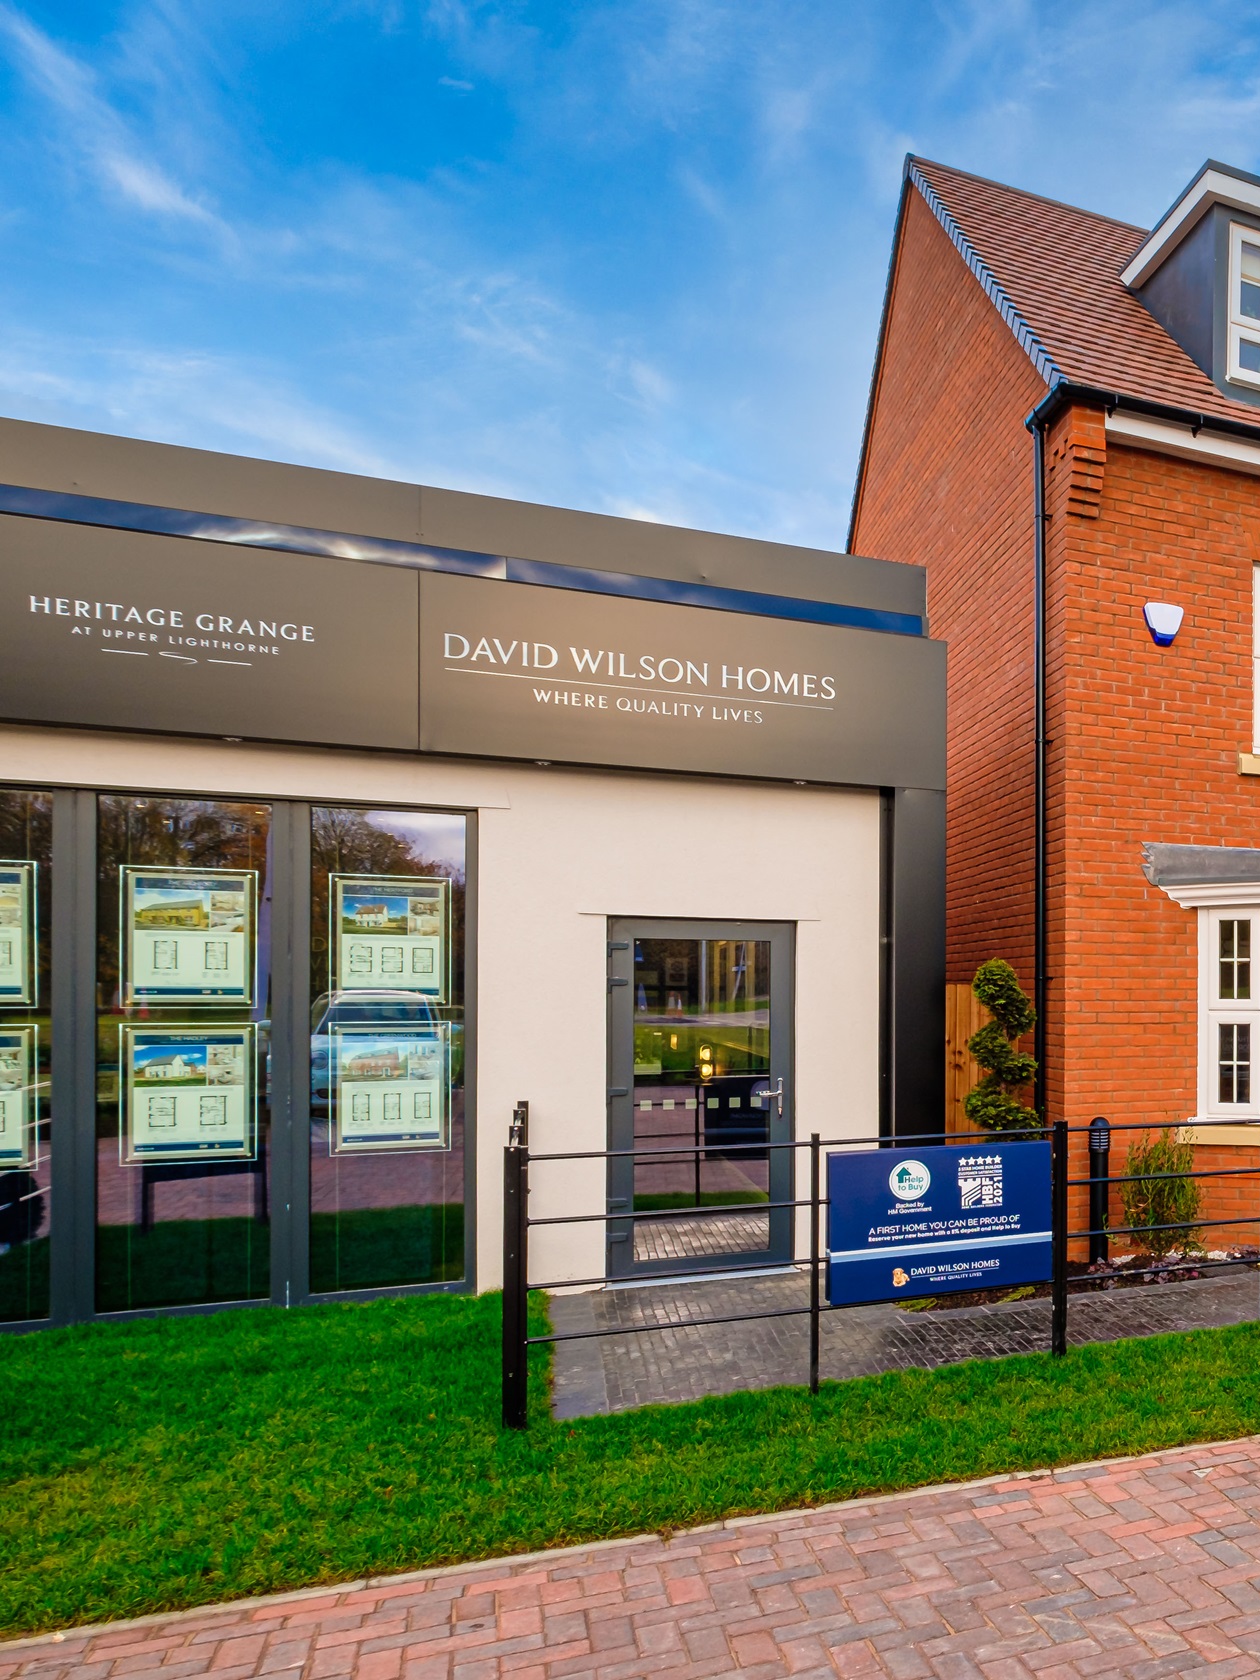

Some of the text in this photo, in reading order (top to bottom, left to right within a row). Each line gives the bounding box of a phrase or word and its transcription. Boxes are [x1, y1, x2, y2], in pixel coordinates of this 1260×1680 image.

[29, 594, 315, 643] HERITAGE GRANGE
[71, 626, 280, 655] AT UPPER LIGHTHORNE
[443, 633, 837, 701] DAVID WILSON HOMES
[533, 688, 764, 725] WHERE QUALITY LIVES
[904, 1176, 924, 1184] Help
[982, 1177, 994, 1205] HBF
[994, 1176, 1002, 1203] 2021
[899, 1206, 932, 1214] Government
[877, 1224, 901, 1234] FIRST
[902, 1222, 928, 1232] HOME
[928, 1220, 947, 1230] YOU
[948, 1219, 966, 1228] CAN
[967, 1218, 978, 1226] BE
[980, 1215, 1008, 1225] PROUD
[1008, 1214, 1020, 1222] OF
[910, 1258, 1000, 1276] DAVID WILSON HOMES
